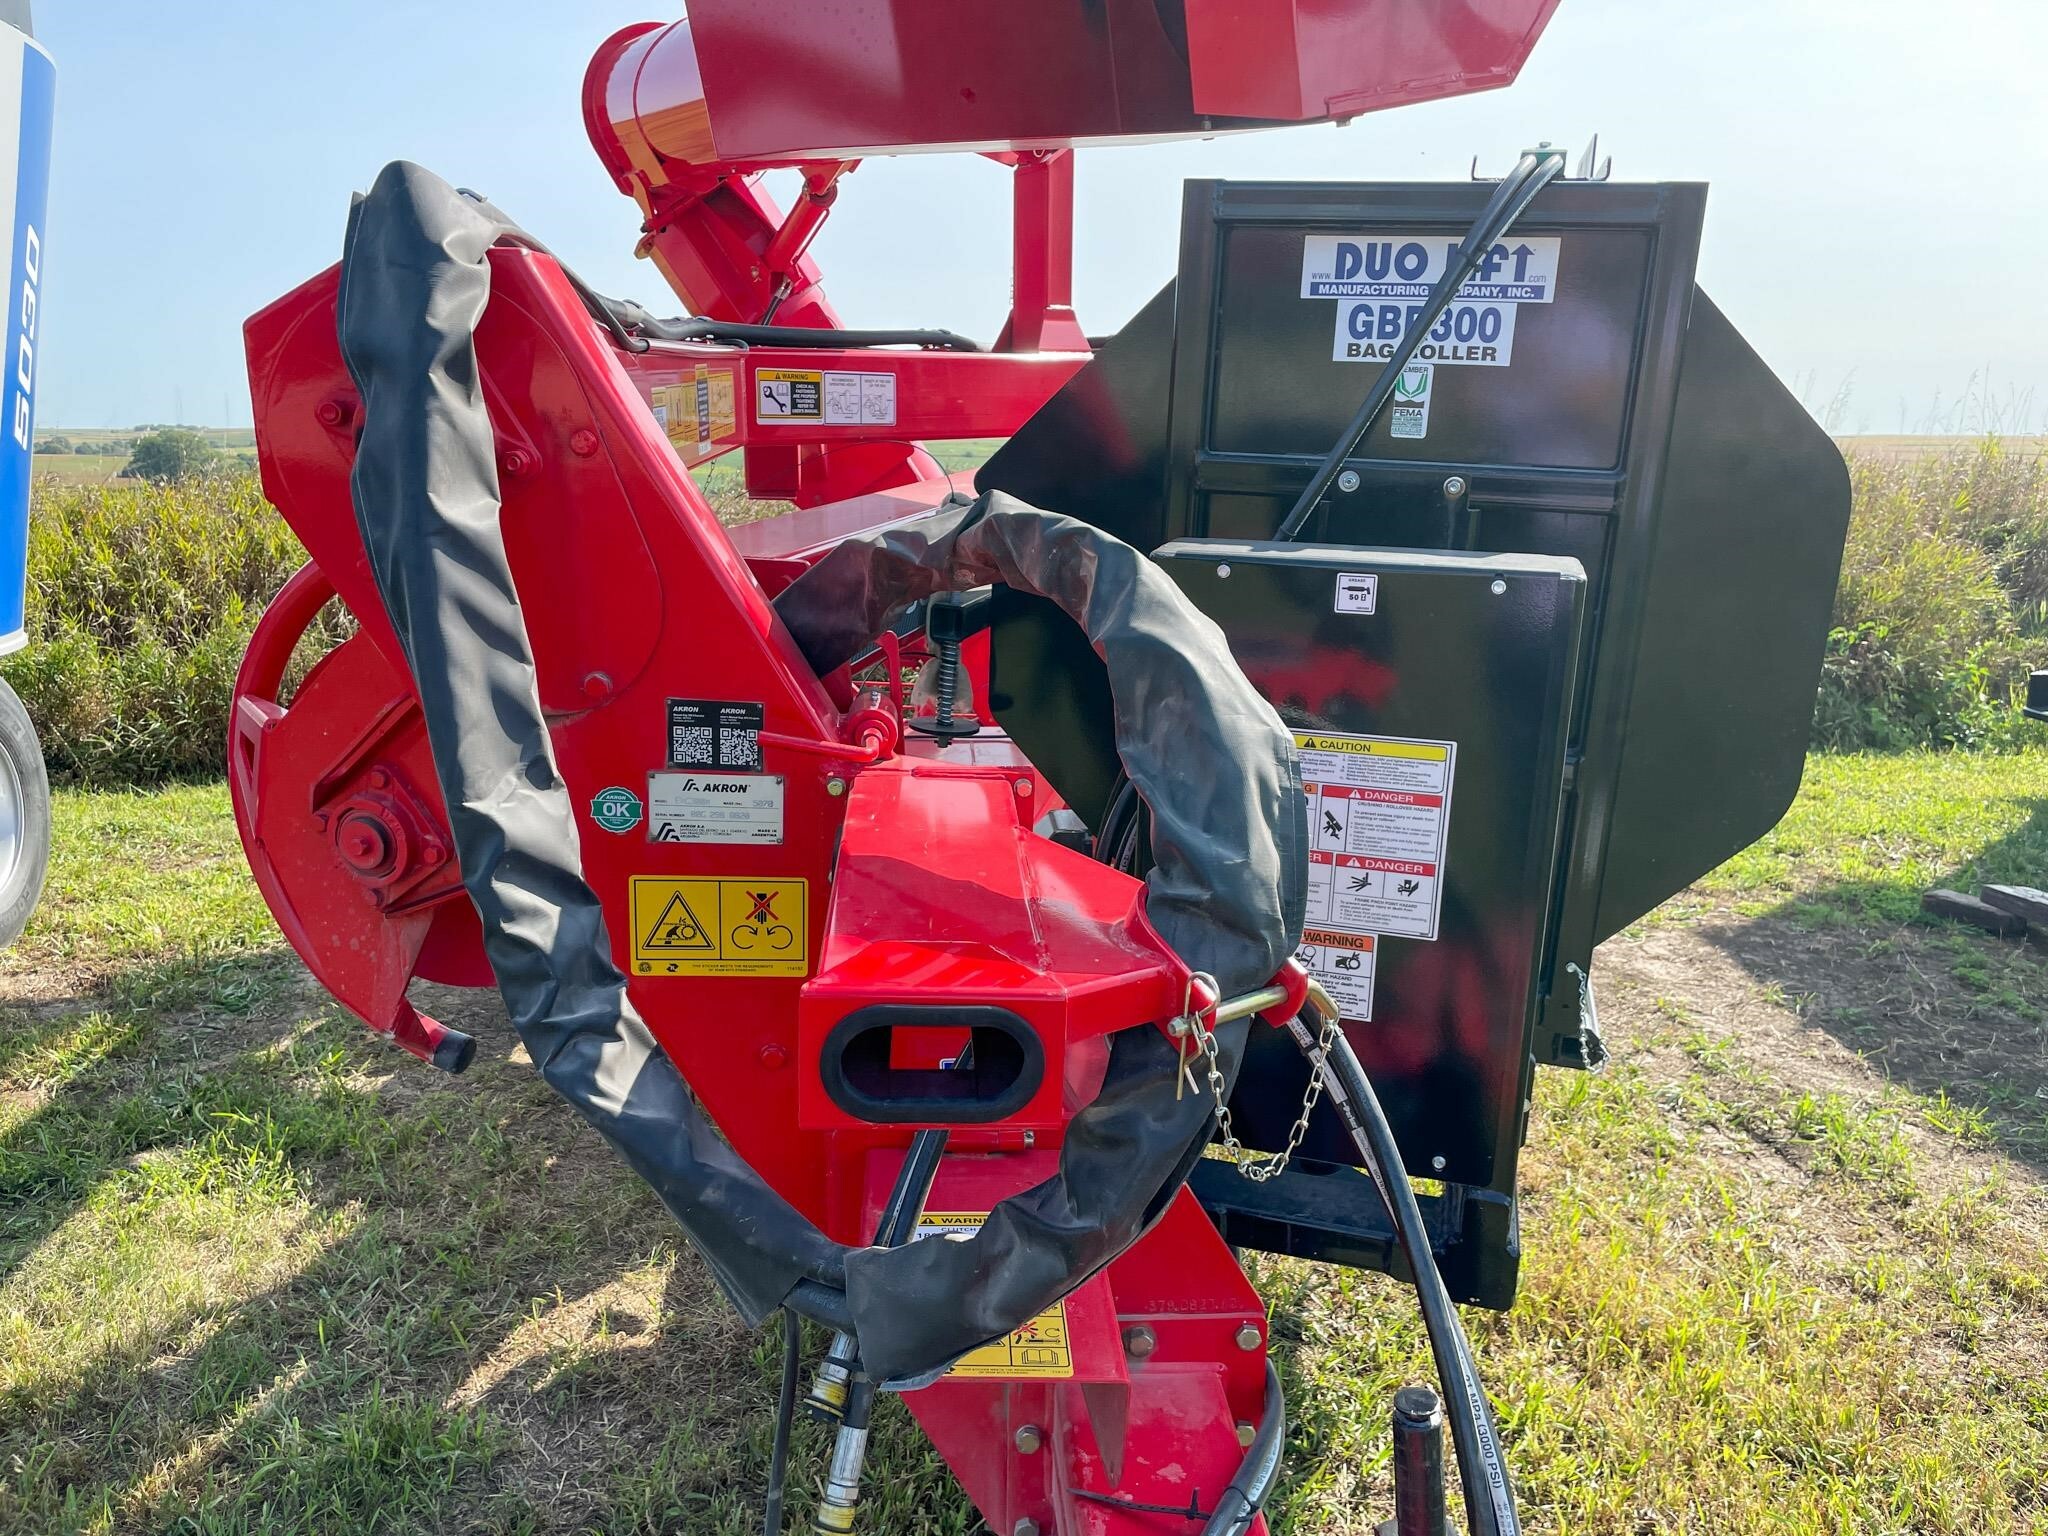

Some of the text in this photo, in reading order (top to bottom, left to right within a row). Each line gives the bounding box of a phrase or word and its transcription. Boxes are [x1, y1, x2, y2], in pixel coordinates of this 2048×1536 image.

[1335, 242, 1429, 281] DUO
[1319, 284, 1430, 296] MANUFACTURING
[1507, 287, 1535, 298] INC.
[14, 224, 40, 450] 5030
[1347, 342, 1497, 362] BAG OLLER
[1394, 408, 1423, 417] FEMA
[673, 705, 699, 713] AKRON
[1320, 740, 1372, 753] CAUTION
[703, 783, 748, 793] AKRON
[1365, 791, 1414, 804] DANGER
[602, 802, 630, 817] OK
[1365, 859, 1424, 874] DANGER
[1303, 931, 1364, 949] WARNING
[1342, 1105, 1357, 1130] Parker
[1477, 1424, 1496, 1459] (3000
[1487, 1462, 1503, 1489] PSI)
